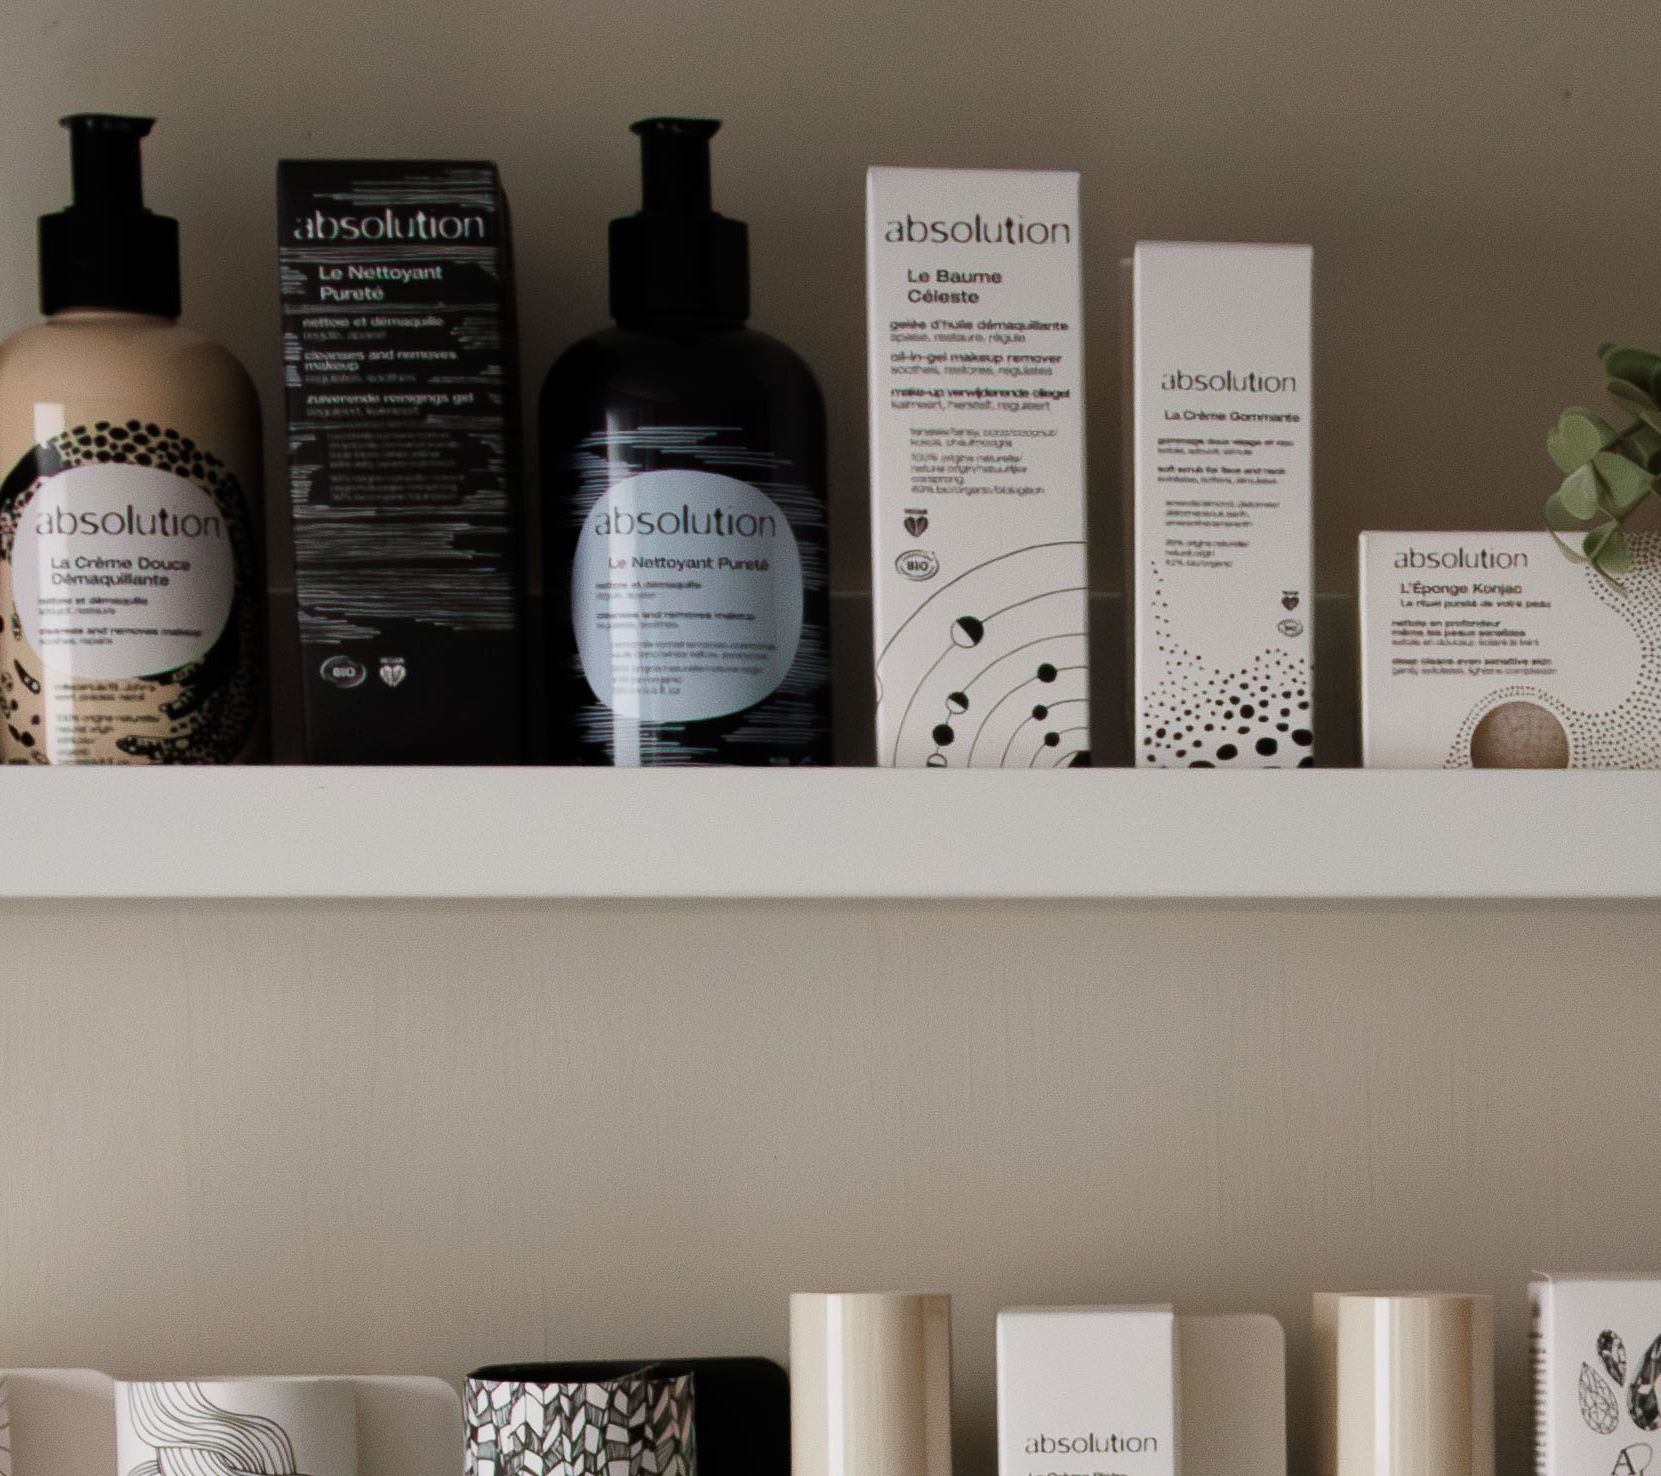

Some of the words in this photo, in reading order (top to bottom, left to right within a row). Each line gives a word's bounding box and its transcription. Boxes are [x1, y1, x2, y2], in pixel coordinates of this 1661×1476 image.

[294, 209, 484, 239] absolution
[885, 213, 1070, 245] absolution
[319, 265, 343, 280] Le
[348, 265, 443, 283] Nettoyant
[907, 269, 930, 283] Le
[936, 269, 1003, 283] Baume
[320, 286, 384, 300] Pureté
[907, 289, 980, 304] Céleste
[1161, 370, 1297, 393] absolution
[1164, 410, 1180, 420] La
[1183, 410, 1227, 421] Crème
[1230, 411, 1301, 423] Gommante
[36, 504, 220, 537] absolution
[595, 504, 777, 537] absolution
[51, 557, 70, 569] La
[75, 556, 132, 570] Crème
[137, 557, 191, 571] Douce
[609, 557, 626, 568] Le
[632, 556, 713, 571] Nettoyant
[718, 556, 770, 571] Pureté
[1394, 547, 1528, 569] absolution
[51, 573, 169, 587] Démaquillante
[1400, 580, 1468, 596] L'Éponge
[1473, 583, 1523, 596] Konjac
[1025, 1433, 1157, 1453] absolution
